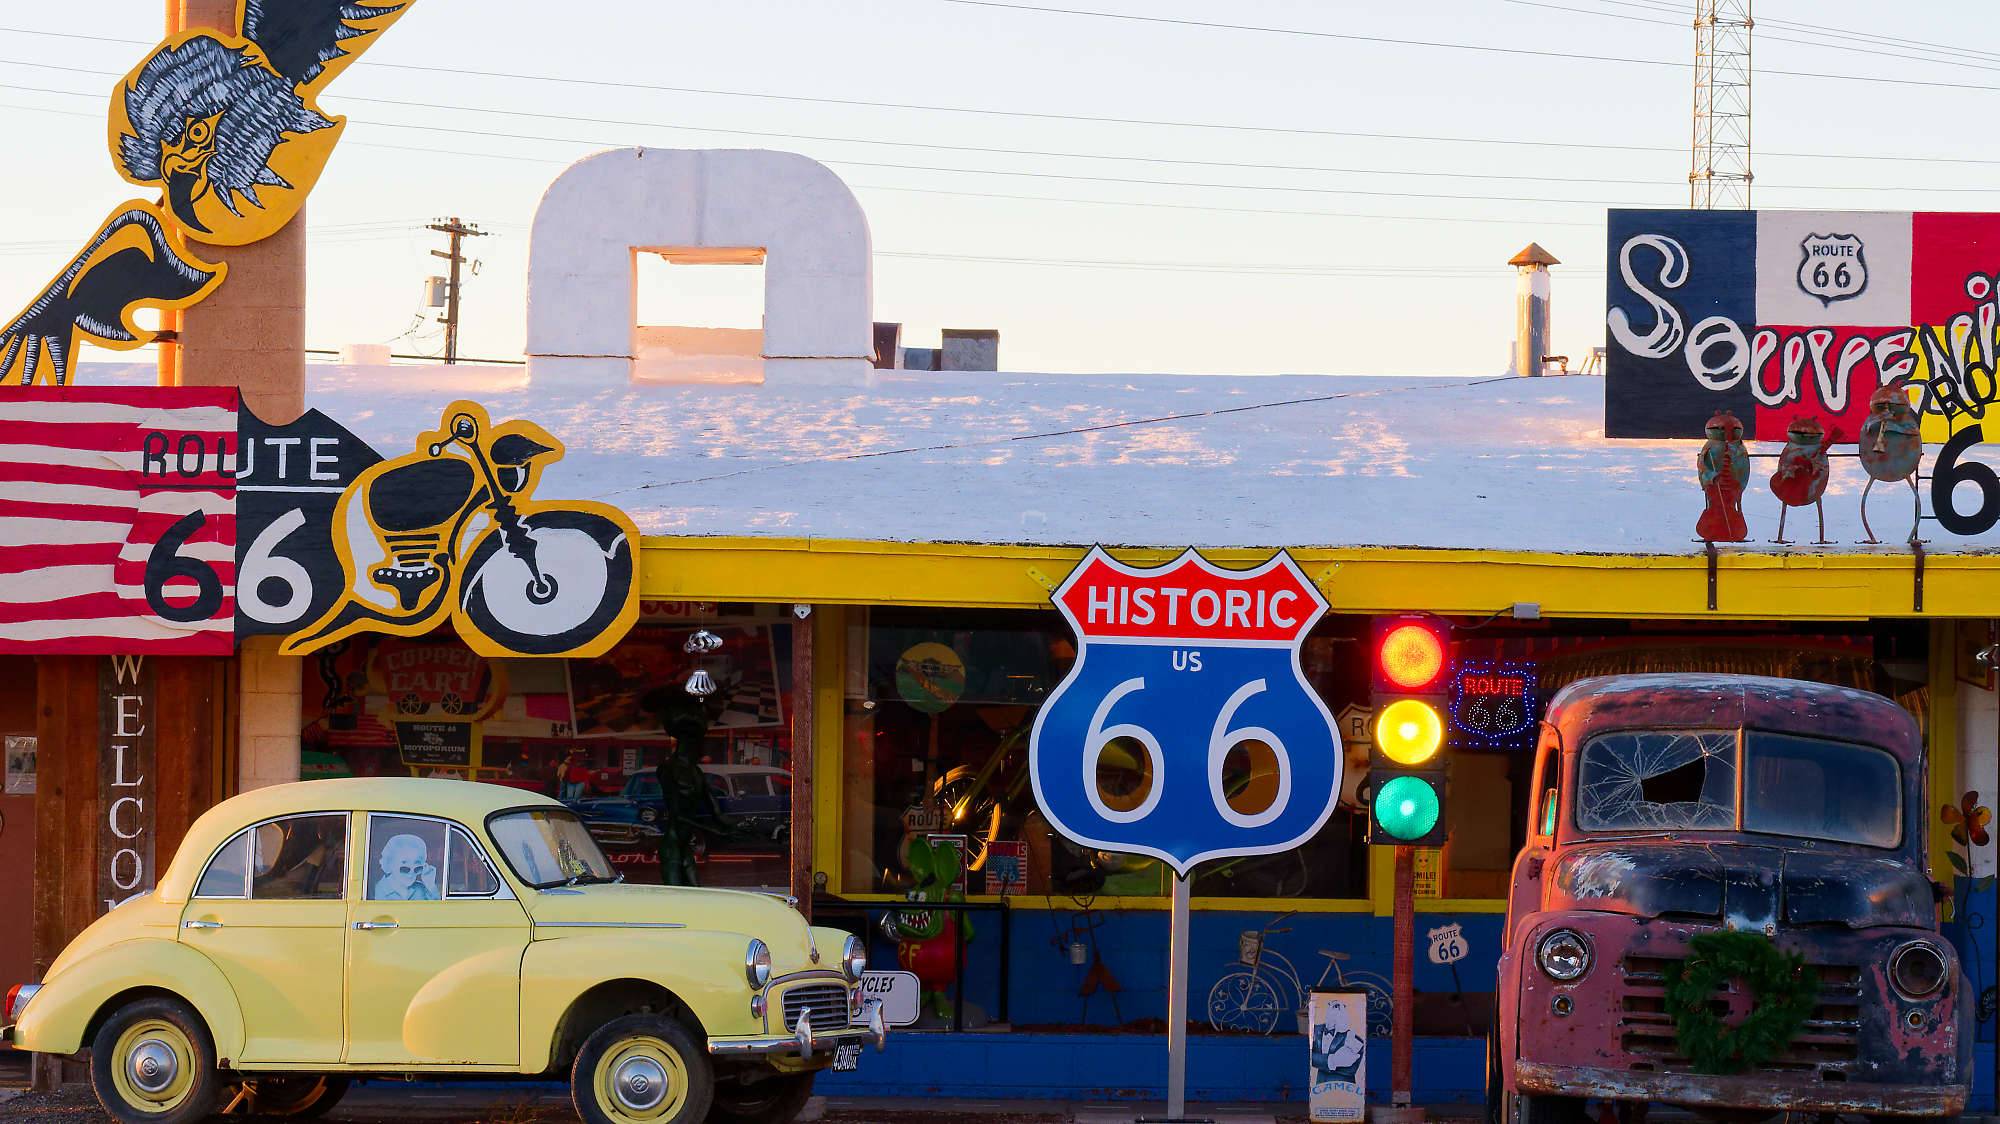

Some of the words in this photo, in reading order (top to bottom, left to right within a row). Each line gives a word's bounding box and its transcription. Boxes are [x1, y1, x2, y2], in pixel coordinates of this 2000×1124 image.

[1812, 244, 1853, 257] ROUTE
[1813, 261, 1851, 288] 66
[142, 430, 340, 481] ROUTE
[144, 507, 313, 624] 66
[1087, 585, 1298, 629] HISTORIC
[1172, 650, 1203, 672] US
[391, 671, 475, 692] CART
[1463, 678, 1523, 696] ROUTE
[1468, 695, 1518, 730] 66
[1083, 676, 1291, 828] 66
[104, 655, 146, 912] WELCO
[1432, 929, 1458, 944] ROUTE
[1438, 939, 1460, 960] 66
[857, 976, 895, 992] YCLES
[1312, 1082, 1363, 1095] CAMEL
